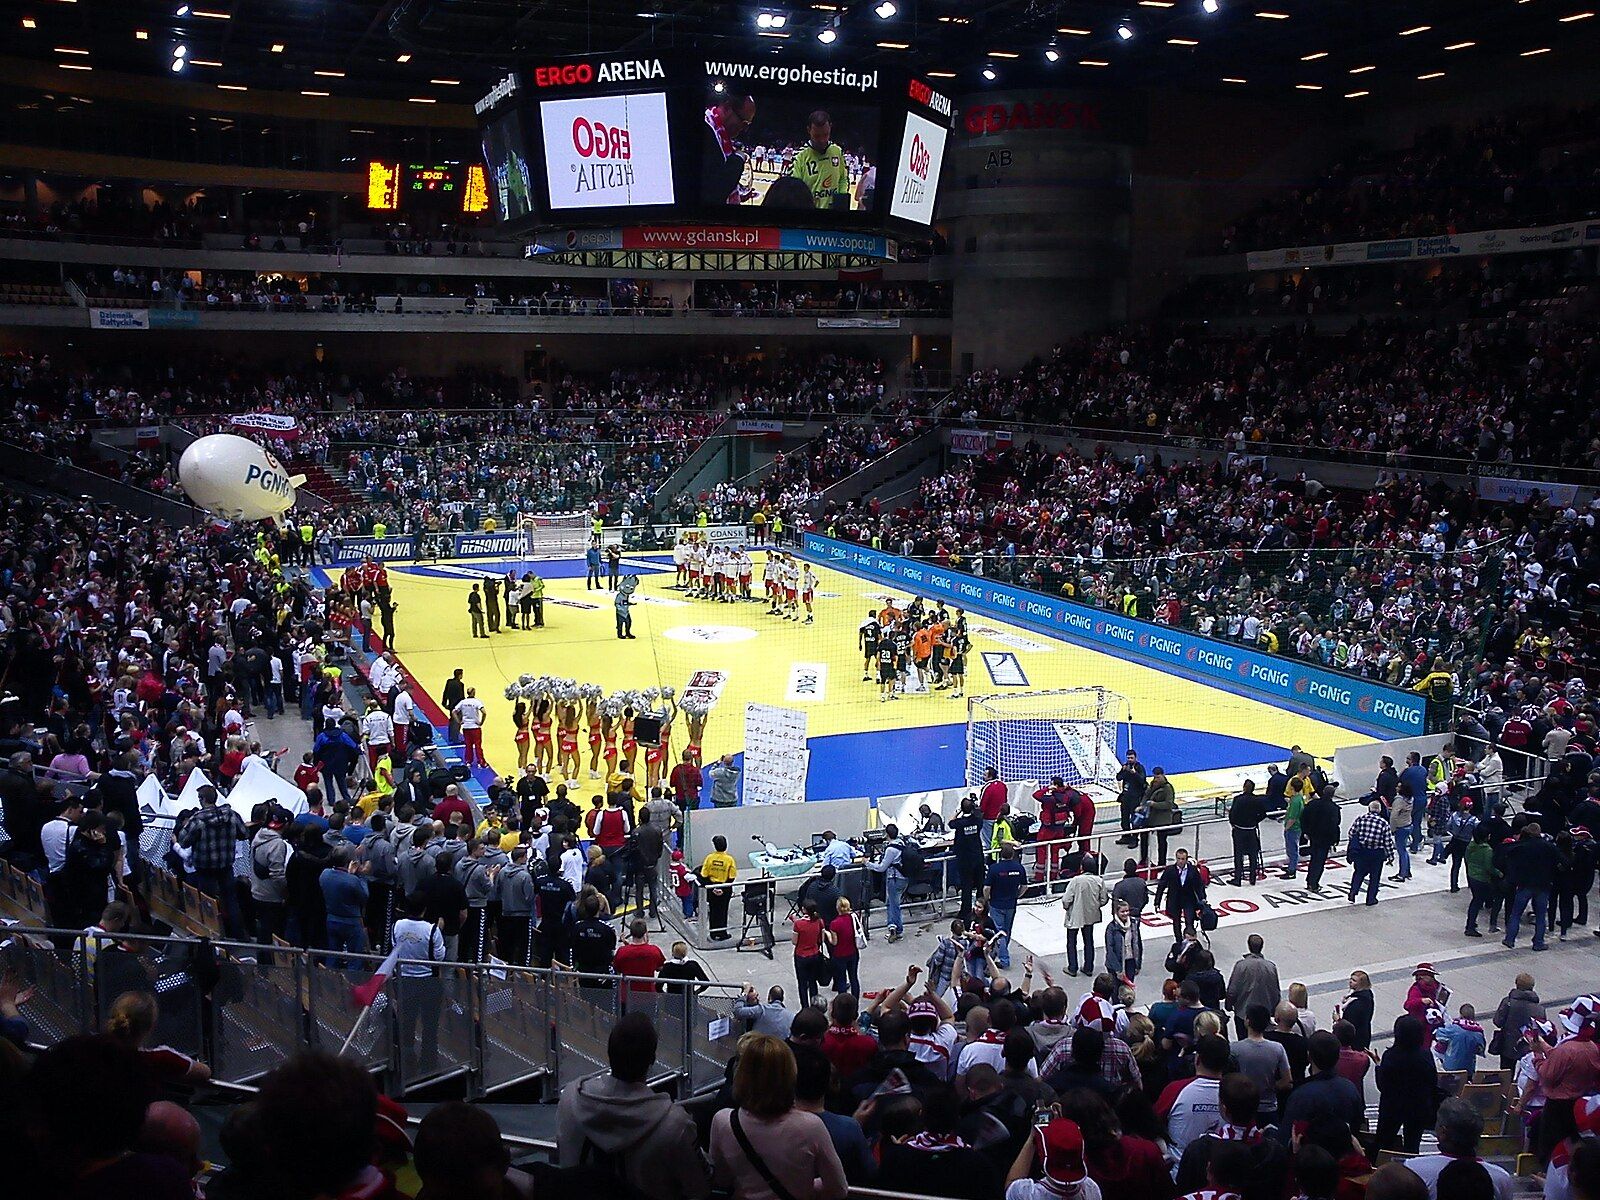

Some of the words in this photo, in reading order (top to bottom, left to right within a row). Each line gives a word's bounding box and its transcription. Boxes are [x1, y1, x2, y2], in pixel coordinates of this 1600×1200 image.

[535, 64, 593, 87] ERGO
[598, 59, 665, 82] ARENA
[705, 61, 878, 91] www.ergohestia.pl
[806, 160, 818, 176] 12
[643, 228, 760, 246] www.gdansk.pl
[806, 234, 876, 254] www.sopot.pl
[244, 464, 289, 497] PGNiG
[338, 542, 411, 560] REMONTOWA
[960, 583, 982, 599] PGNiG
[992, 592, 1015, 609] PGNiG
[1027, 602, 1052, 618] PGNiG
[1064, 612, 1091, 630] PGNiG
[1104, 623, 1134, 643] PGNiG
[1149, 635, 1181, 657] PGNiG
[1198, 649, 1233, 671] PGNiG
[1251, 665, 1289, 688] PGNiG
[1308, 681, 1351, 706] PGNiG
[1373, 699, 1421, 725] PGNiG
